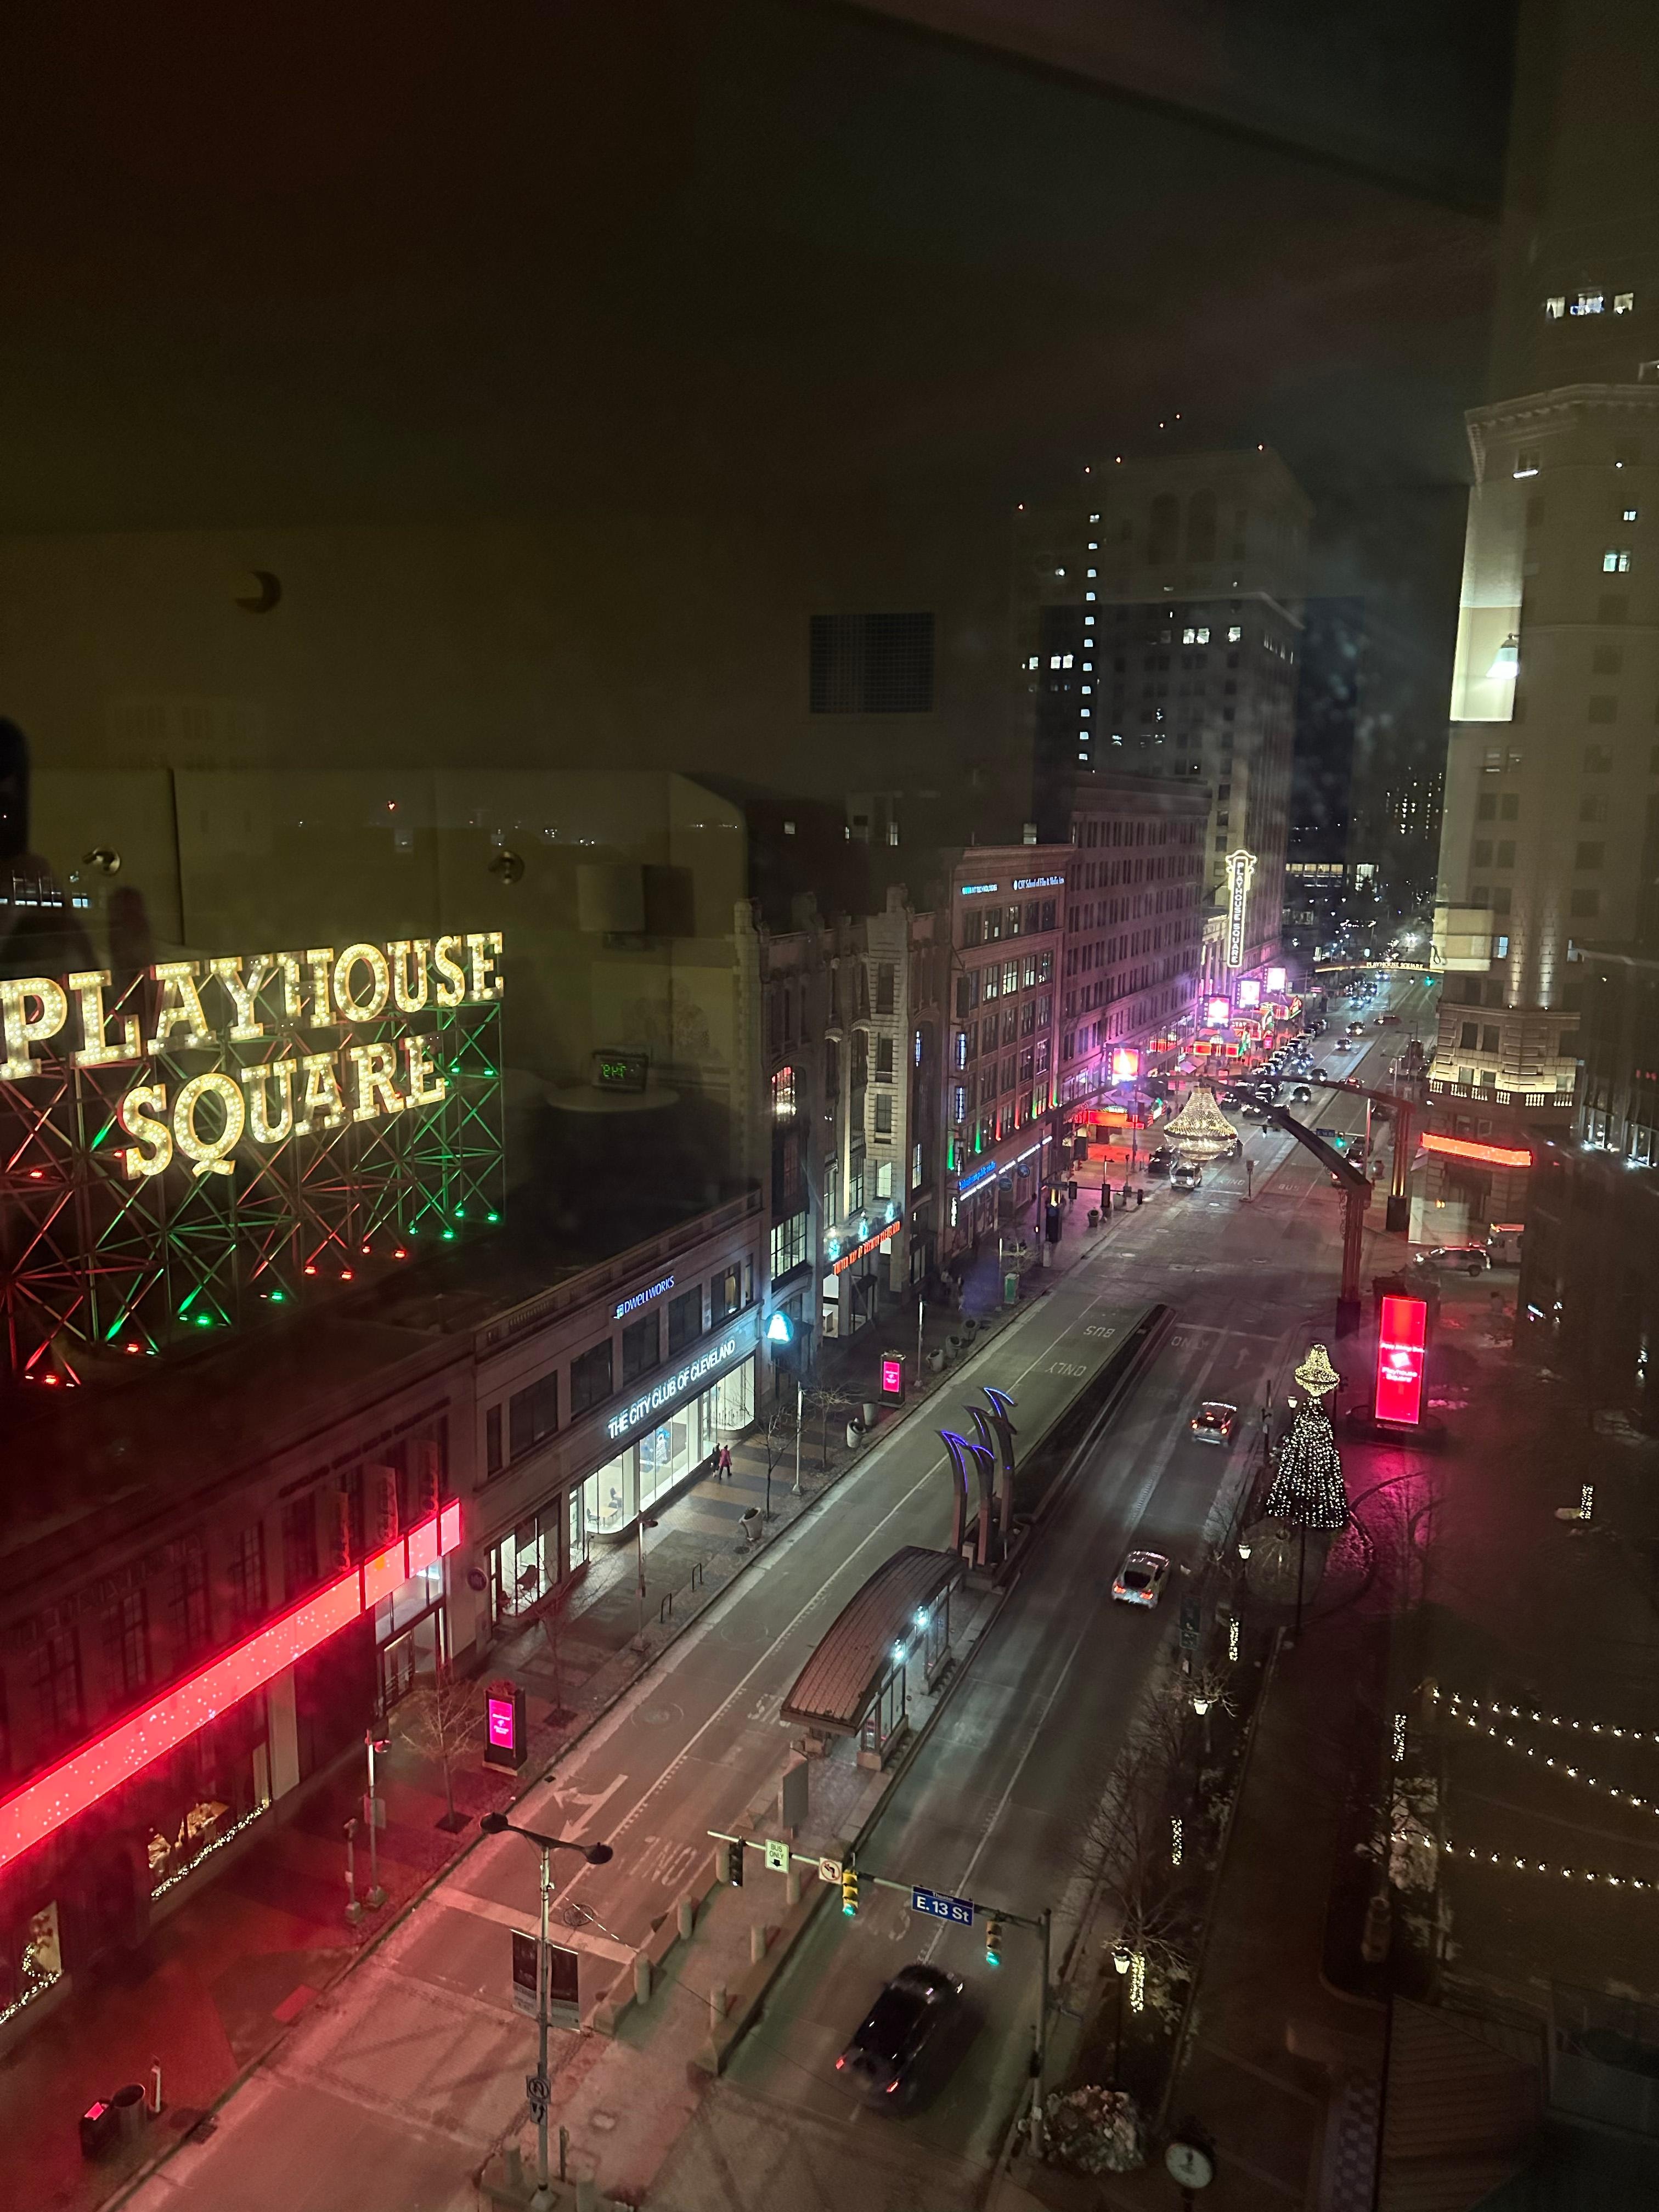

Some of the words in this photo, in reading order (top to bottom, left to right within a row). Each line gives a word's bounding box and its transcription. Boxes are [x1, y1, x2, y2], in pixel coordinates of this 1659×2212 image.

[1234, 862, 1244, 921] PLAYHOUSE
[1231, 923, 1240, 963] SQUARE
[0, 932, 504, 1081] PLAYHOUSE
[119, 1035, 446, 1180] SQUARE
[1083, 1325, 1115, 1338] BUS
[1045, 1362, 1086, 1376] ONLY
[608, 1415, 629, 1439] THE
[629, 1396, 652, 1424] CITY
[652, 1379, 676, 1408] CLUB
[677, 1372, 690, 1391] OF
[691, 1339, 736, 1380] CLEVELAND
[769, 1850, 784, 1860] ONLY
[771, 1843, 783, 1853] BUS
[916, 1895, 929, 1911] E.
[932, 1901, 949, 1915] 13
[951, 1906, 969, 1922] St
